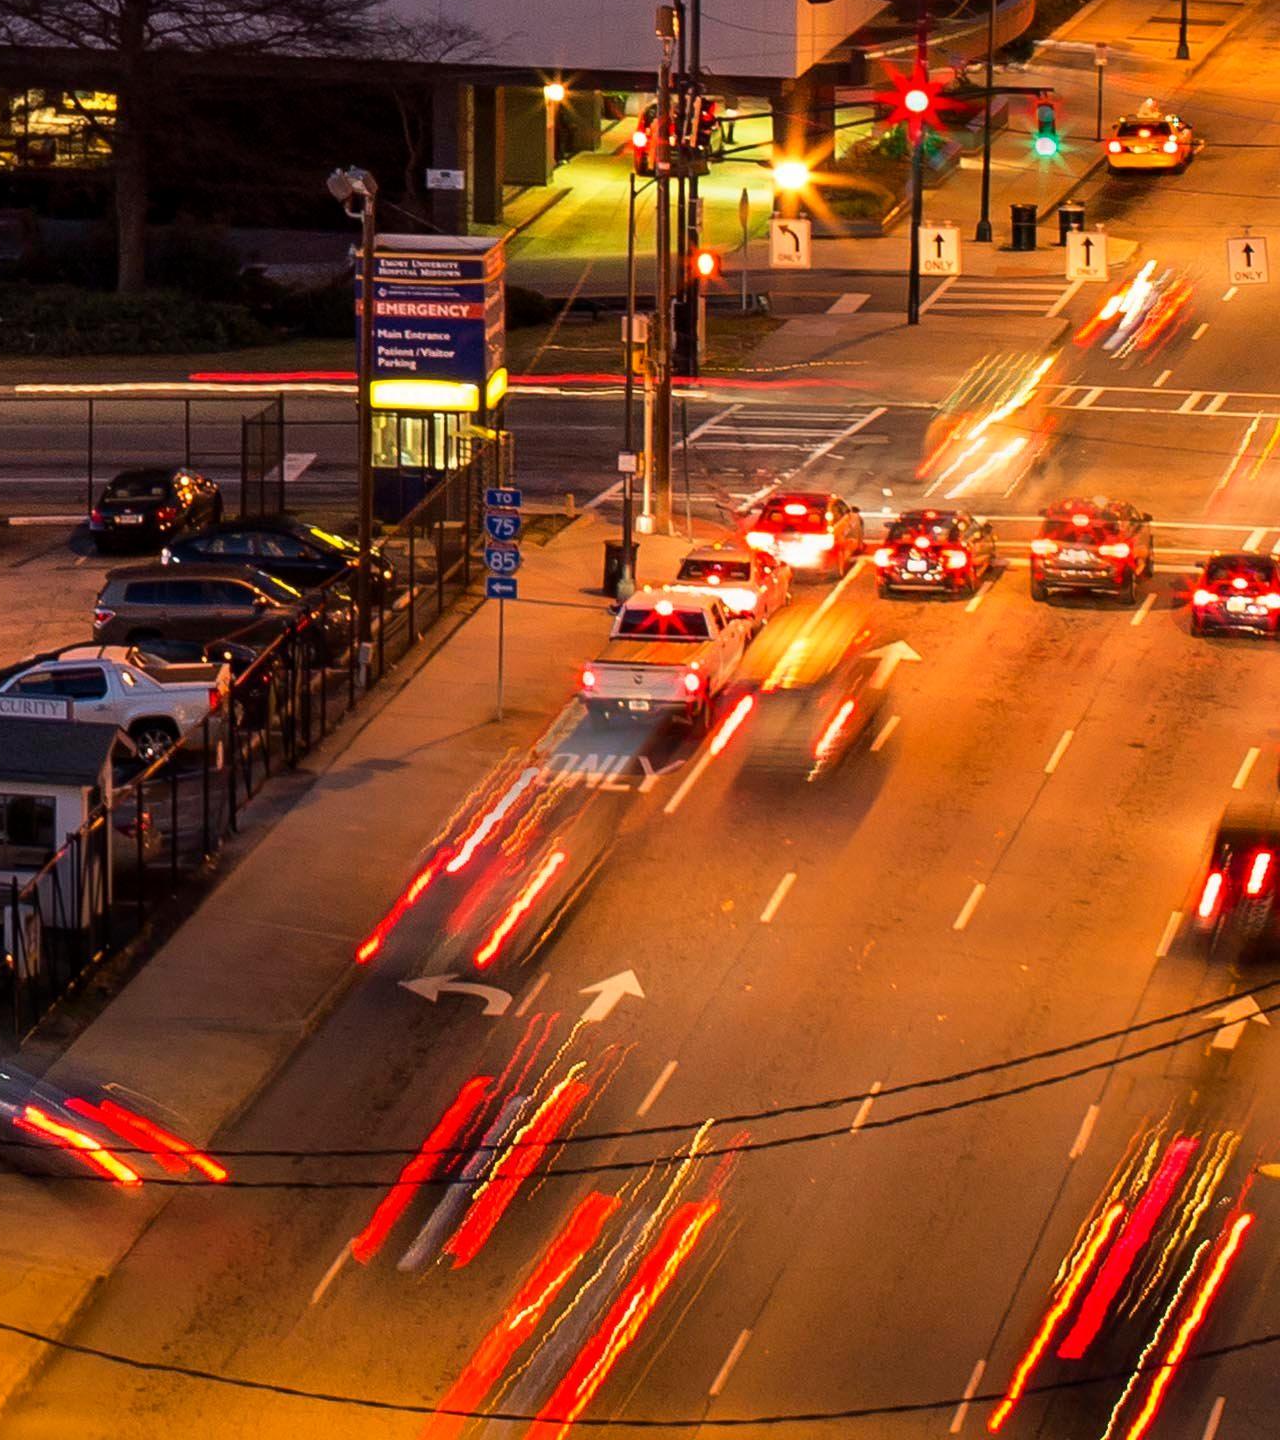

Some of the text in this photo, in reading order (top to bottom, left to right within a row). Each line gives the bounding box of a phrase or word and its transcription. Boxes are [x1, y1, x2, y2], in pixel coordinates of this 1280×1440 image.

[924, 259, 954, 272] ONLY
[1234, 271, 1263, 281] ONLY
[376, 302, 470, 317] EMERGENCY
[377, 329, 451, 341] Main Entrance
[377, 345, 414, 357] Patient
[420, 347, 455, 358] Visitor
[377, 357, 417, 371] Parking
[495, 493, 512, 504] TO
[492, 518, 514, 536] 75
[490, 551, 516, 572] 85
[534, 753, 687, 793] ONLY
